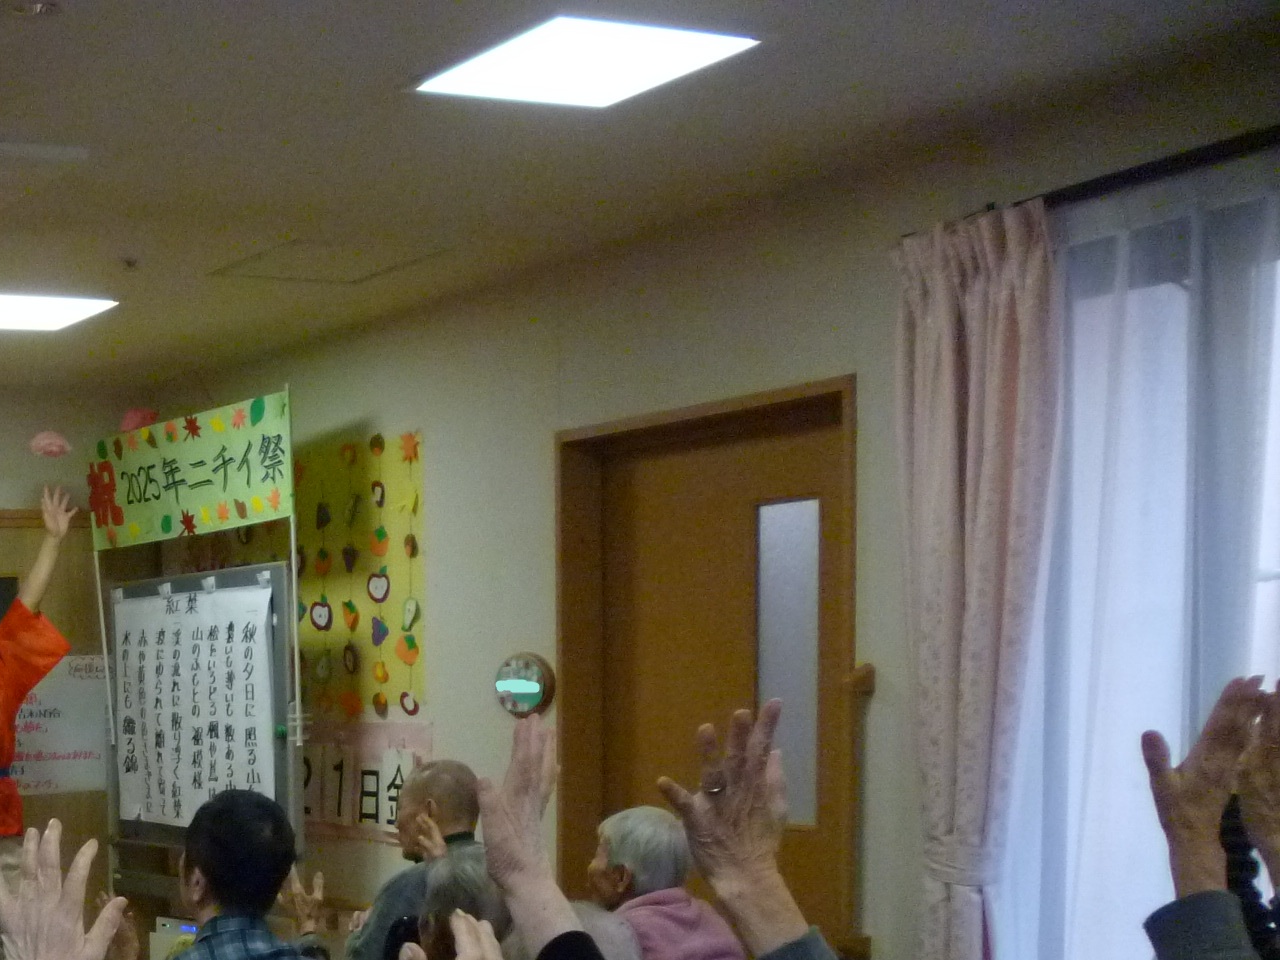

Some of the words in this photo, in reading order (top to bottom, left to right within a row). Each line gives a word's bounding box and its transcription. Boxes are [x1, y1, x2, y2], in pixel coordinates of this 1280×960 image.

[87, 460, 124, 528] 祝
[120, 433, 286, 505] 2025年ニチイ祭
[165, 592, 199, 615] 紅葉
